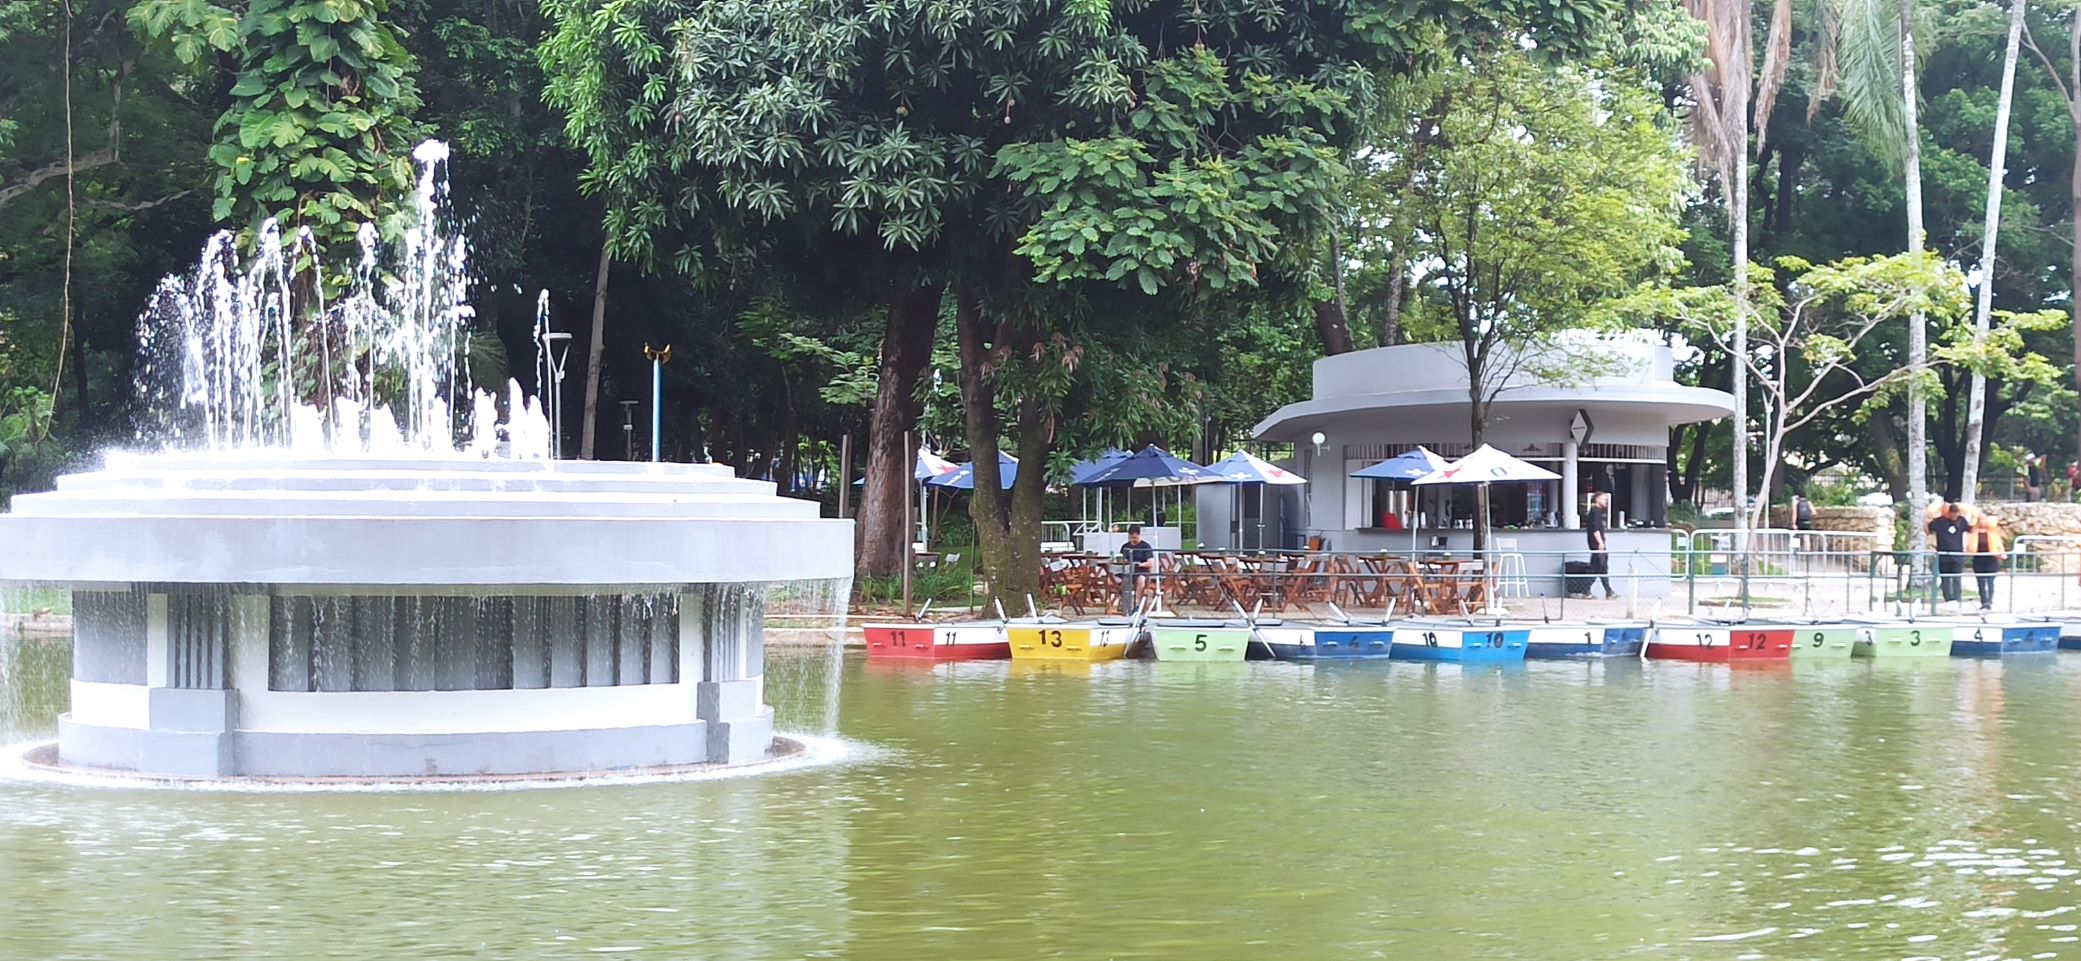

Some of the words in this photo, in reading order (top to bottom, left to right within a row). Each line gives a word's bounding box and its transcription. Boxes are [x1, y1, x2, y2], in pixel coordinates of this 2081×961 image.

[890, 630, 906, 647] 11
[945, 631, 957, 647] 11
[1038, 629, 1063, 648] 13
[1100, 630, 1110, 648] 13
[1422, 631, 1438, 648] 10
[1485, 632, 1504, 648] 10
[1584, 631, 1592, 645] 1
[1696, 633, 1713, 649] 12
[1747, 633, 1767, 649] 12
[1812, 632, 1824, 648] 9
[1865, 630, 1873, 646] 3
[1910, 630, 1921, 646] 3
[1974, 627, 1983, 642] 4
[1194, 634, 1208, 652] 5
